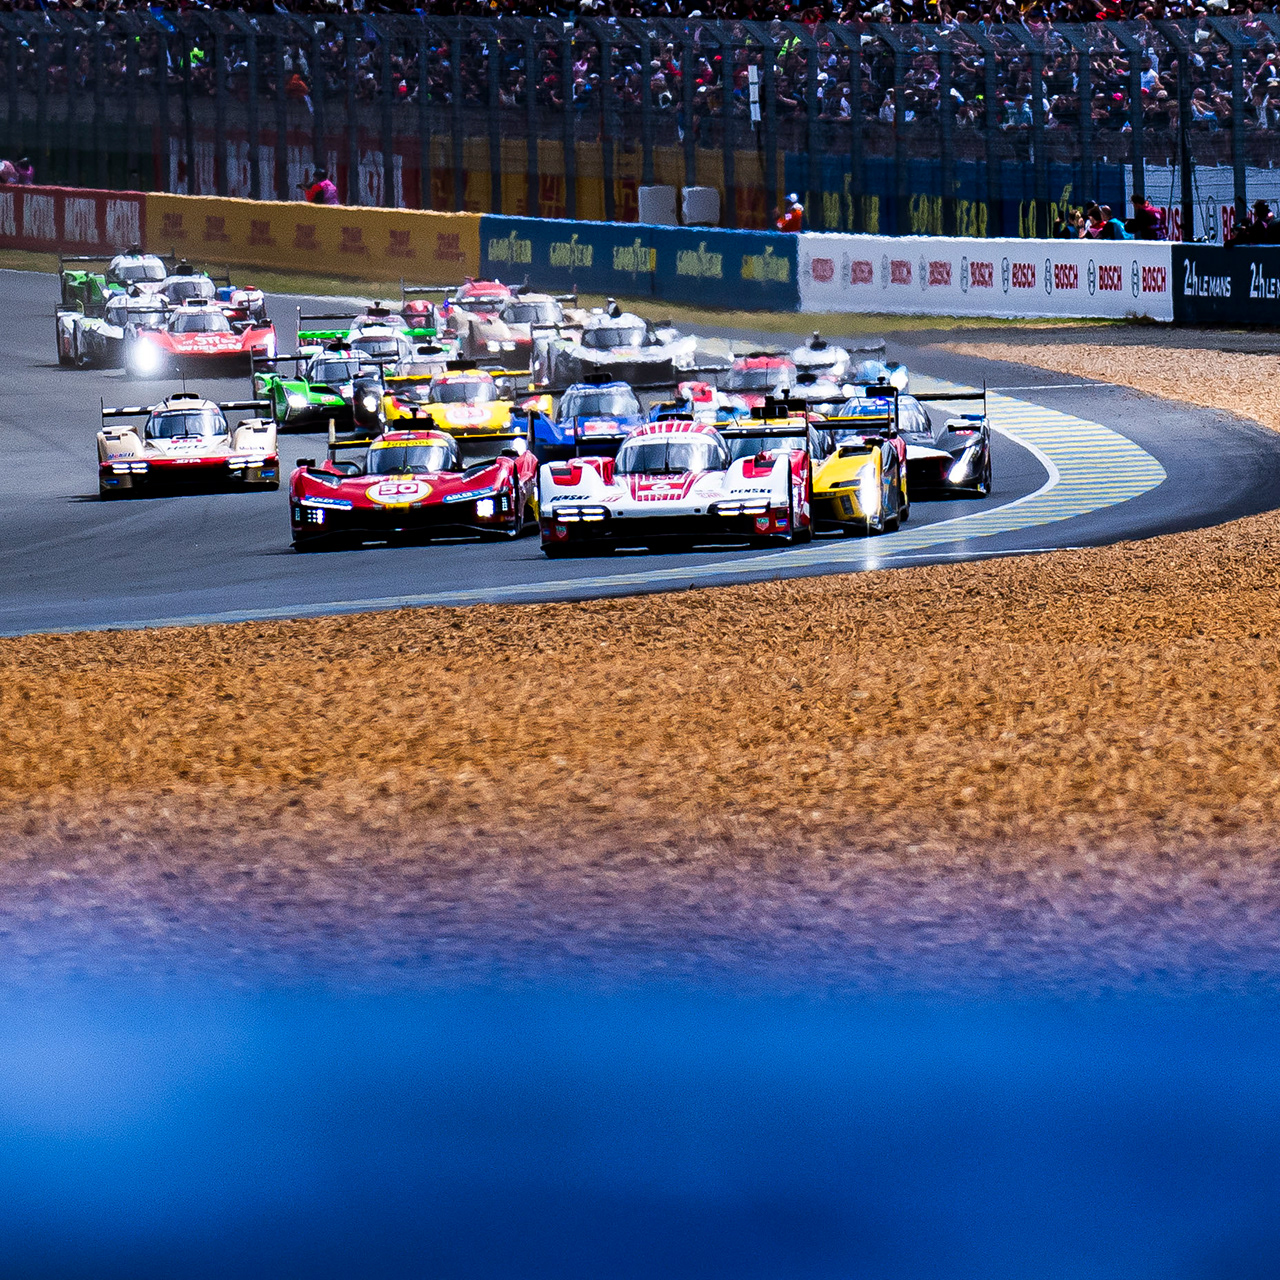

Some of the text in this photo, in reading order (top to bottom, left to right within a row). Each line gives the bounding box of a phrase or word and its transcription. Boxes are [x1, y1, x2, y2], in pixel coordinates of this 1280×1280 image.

[1011, 262, 1036, 288] BOSCH
[1053, 263, 1079, 289] BOSCH
[1098, 265, 1122, 291] BOSCH
[1141, 266, 1166, 293] BOSCH
[1183, 258, 1232, 297] 24h LE MANS
[1249, 261, 1265, 299] 24h
[1266, 278, 1276, 298] LE
[309, 496, 334, 504] ADLER
[380, 484, 419, 496] 50
[446, 490, 473, 502] ADLER
[549, 494, 592, 503] PENSKE
[729, 487, 773, 495] PENSKE
